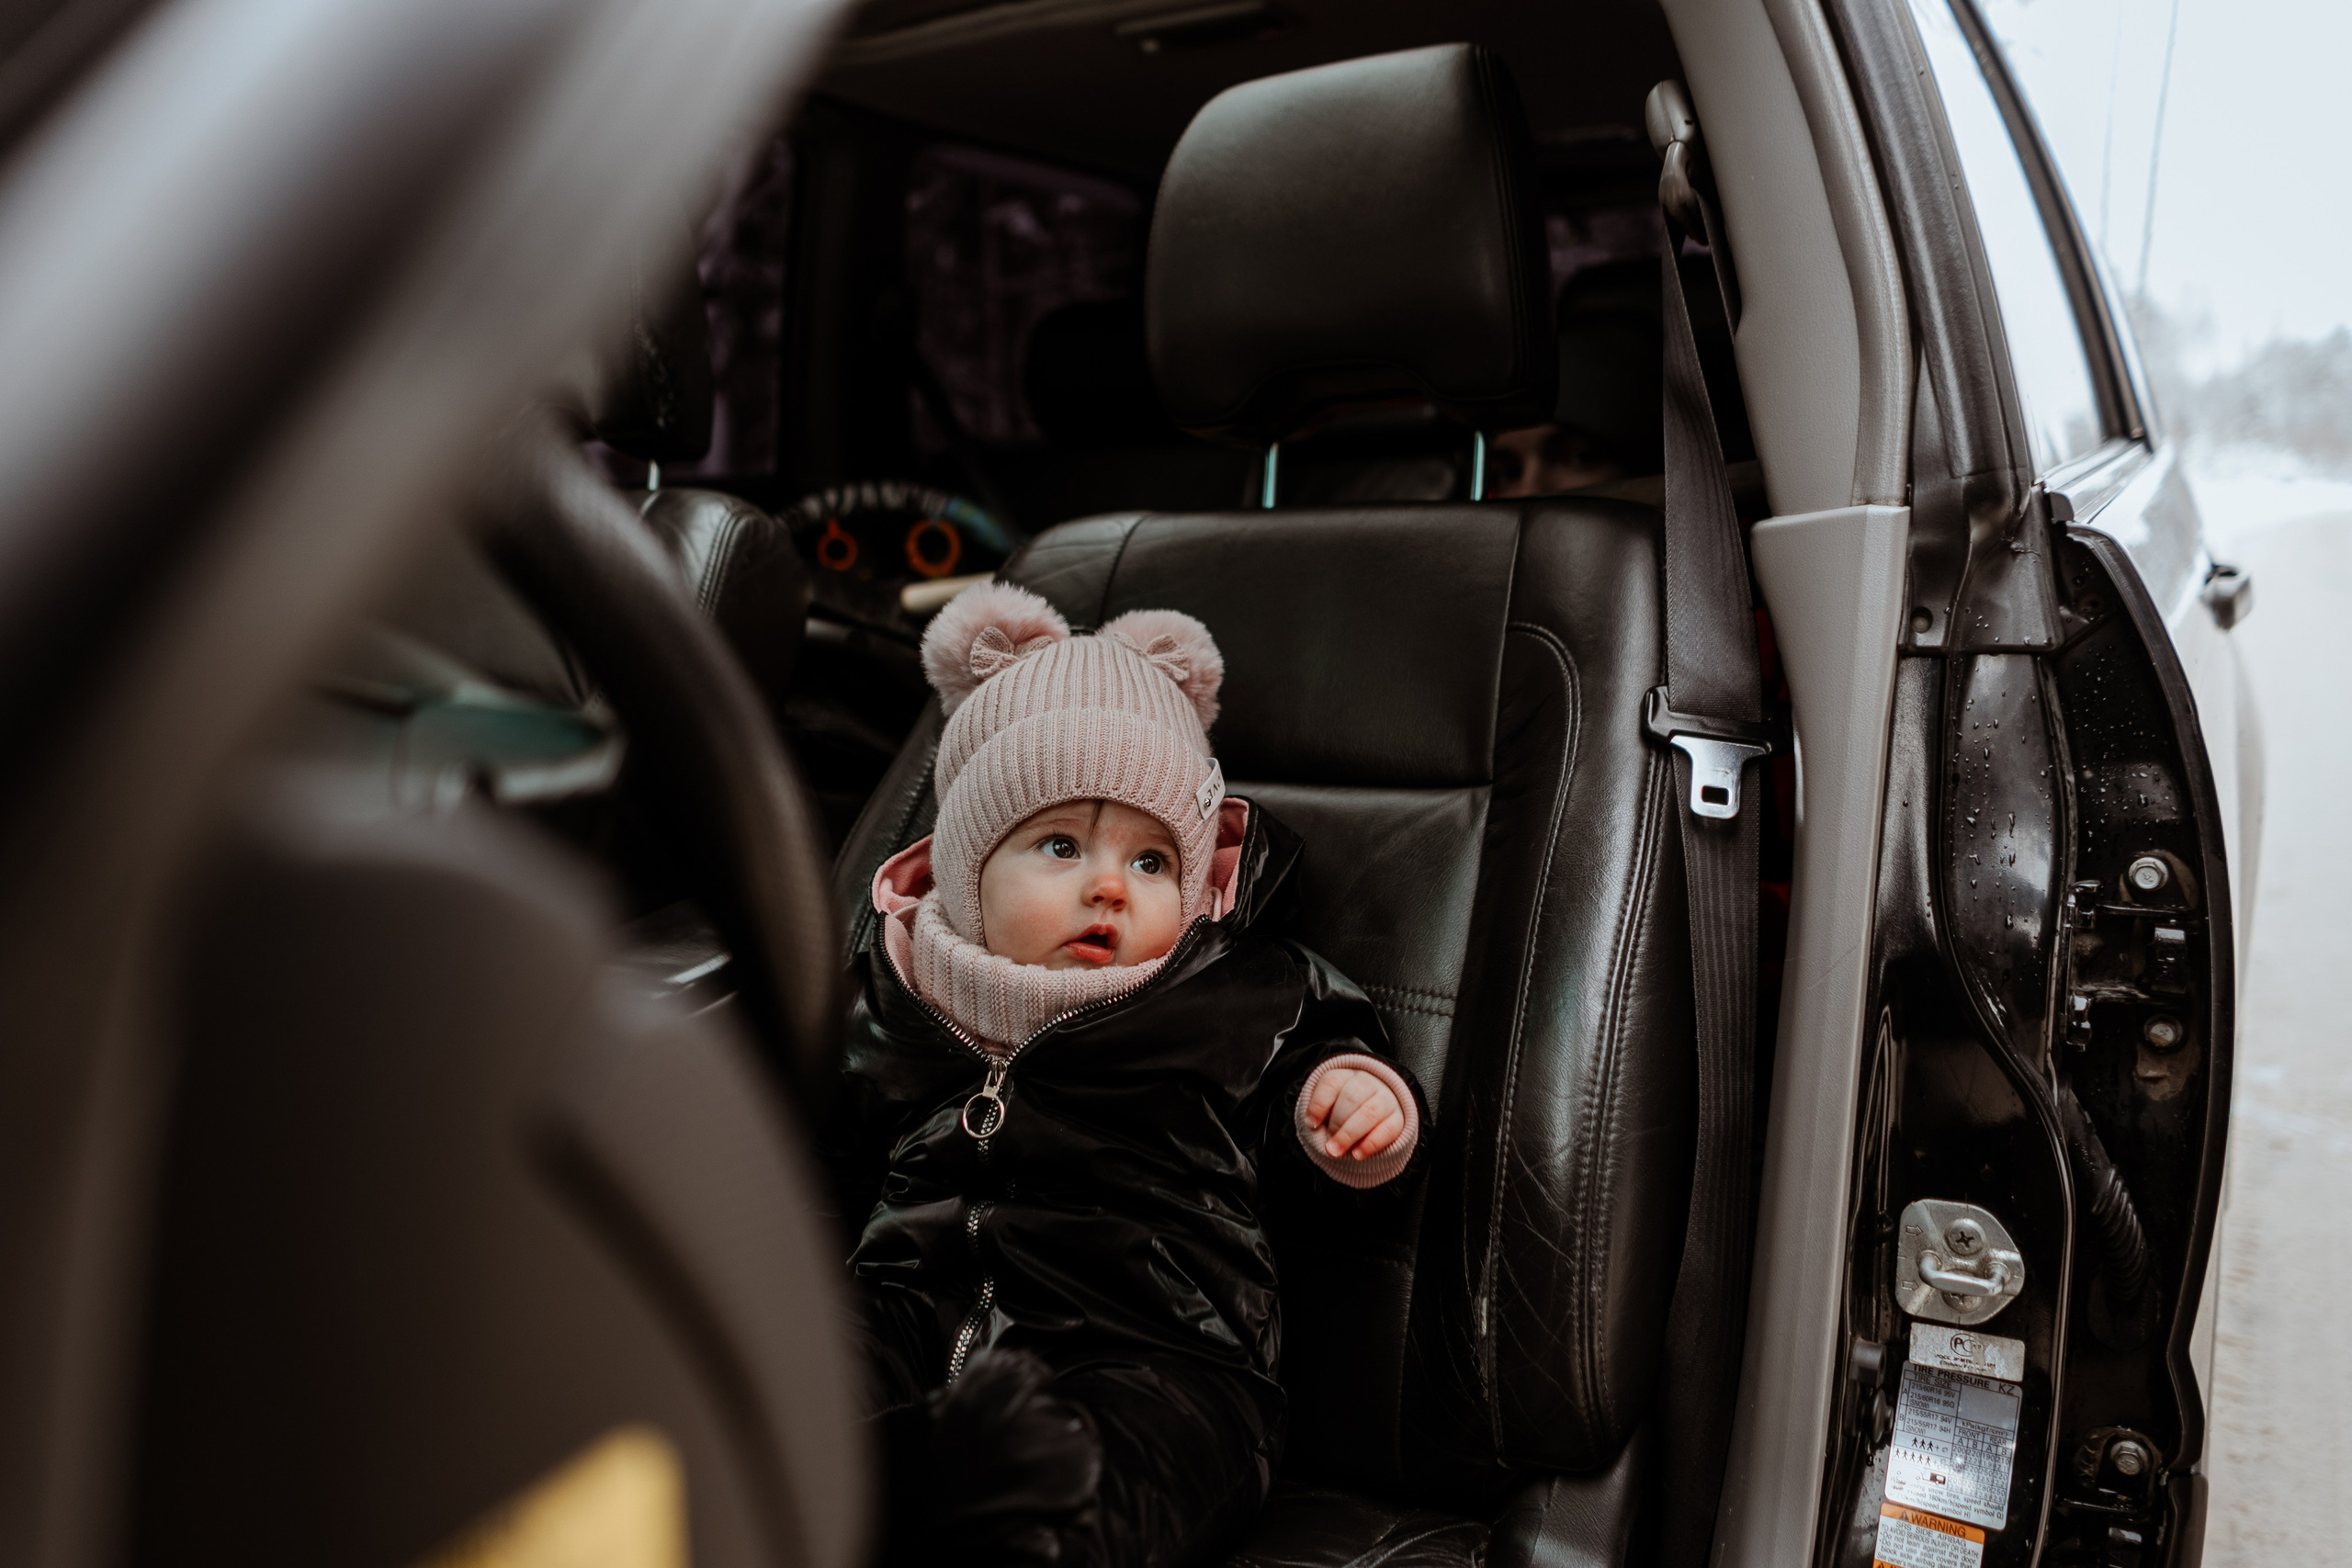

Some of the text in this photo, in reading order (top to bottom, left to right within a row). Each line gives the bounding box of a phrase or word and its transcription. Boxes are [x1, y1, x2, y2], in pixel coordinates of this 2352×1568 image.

[1913, 1364, 2016, 1394] TIRE PRESSURE KZ
[1914, 1372, 1952, 1389] TIRE SIZE
[1958, 1428, 1980, 1439] FRONT
[1989, 1436, 2007, 1446] REAR
[1952, 1446, 1966, 1454] 200
[1967, 1450, 1981, 1458] 220
[1982, 1453, 1996, 1461] 190
[1941, 1506, 1962, 1517] symbol
[1963, 1497, 1982, 1506] speed
[1984, 1500, 2004, 1512] should
[1973, 1506, 1995, 1517] symbol
[1911, 1512, 1967, 1539] WARNING
[1881, 1523, 1889, 1532] TO
[1890, 1527, 1906, 1537] AVOID
[1906, 1530, 1930, 1544] SERIOUS
[1930, 1539, 1950, 1550] INJURY
[1951, 1544, 1959, 1552] OR
[1895, 1520, 1967, 1548] SRS SIDE AIRBAG
[1880, 1545, 1897, 1556] block
[1899, 1551, 1913, 1562] side
[1893, 1543, 1904, 1551] not
[1905, 1547, 1917, 1555] use
[1919, 1551, 1934, 1561] seat
[1936, 1556, 1958, 1567] covers
[1894, 1536, 1905, 1544] not
[1906, 1538, 1920, 1549] lean
[1922, 1544, 1946, 1557] against
[1948, 1551, 1959, 1561] the
[1876, 1551, 1887, 1562] See
